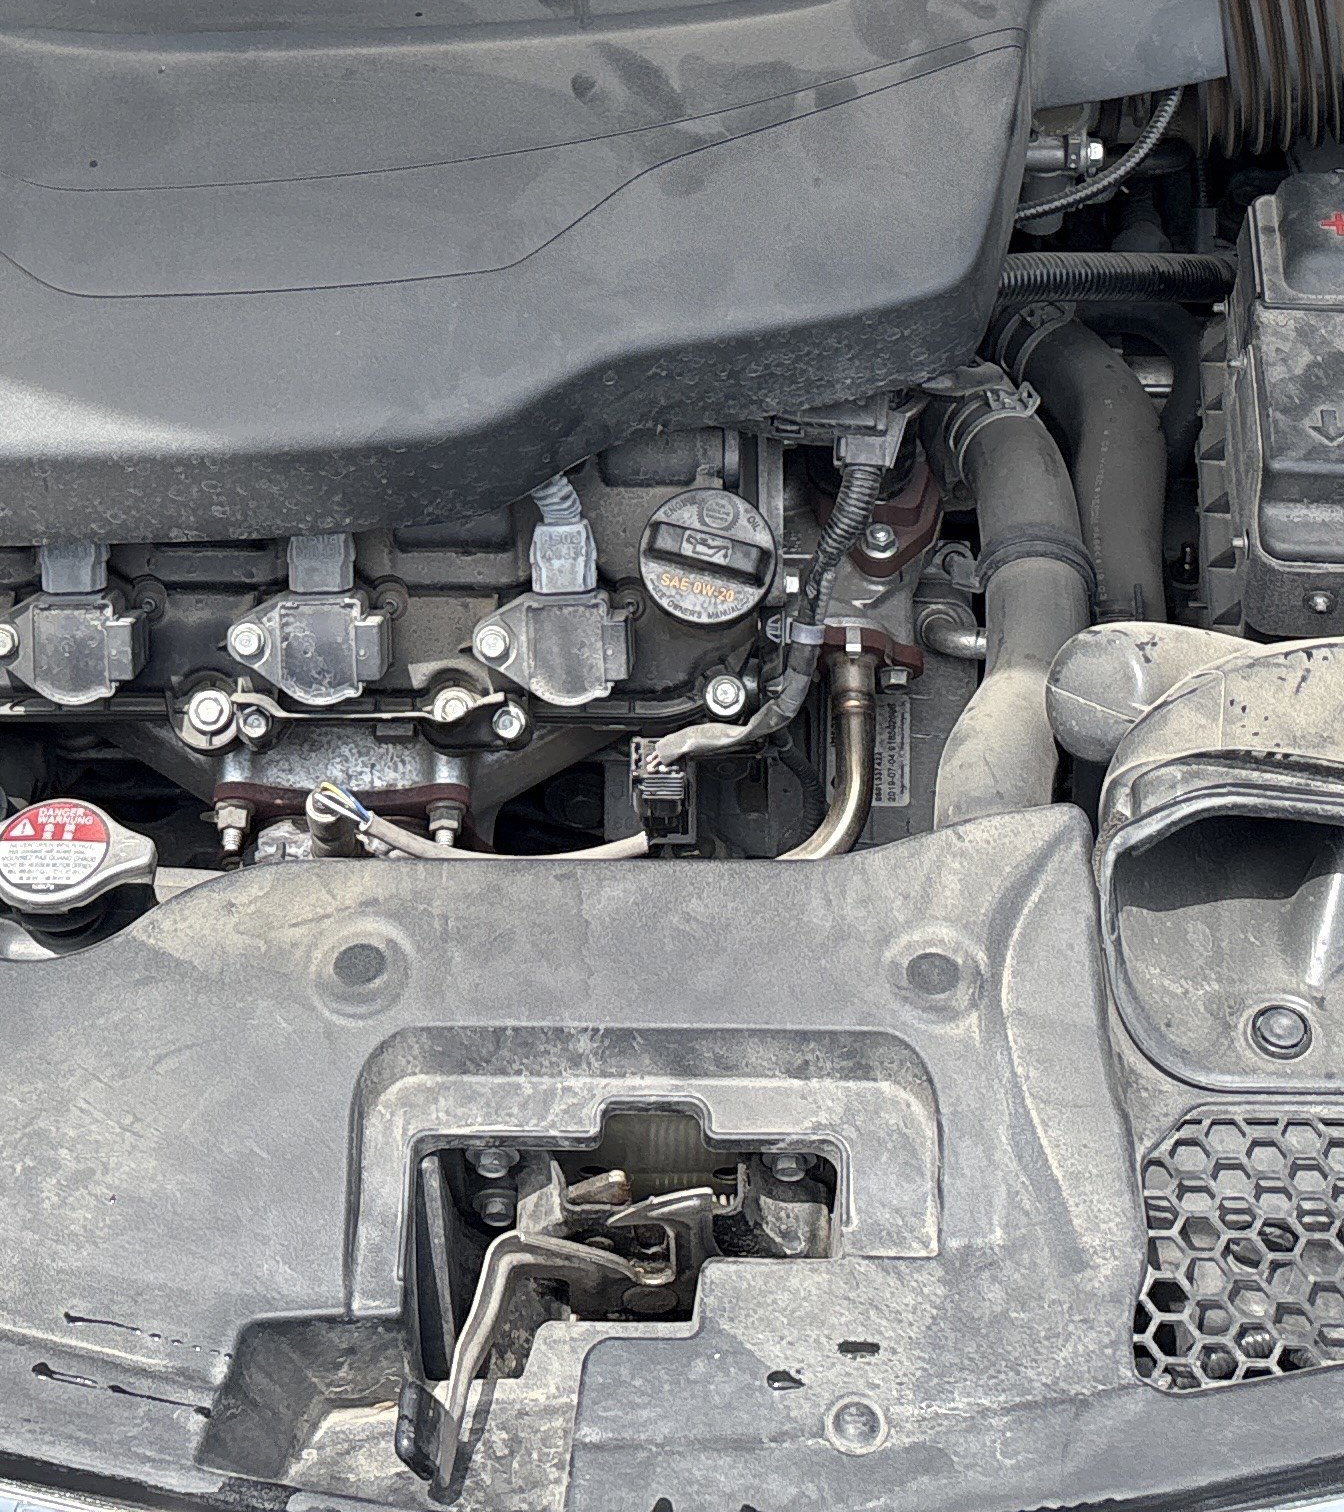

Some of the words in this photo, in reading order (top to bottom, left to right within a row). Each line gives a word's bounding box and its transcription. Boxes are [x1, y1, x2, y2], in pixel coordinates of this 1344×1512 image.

[660, 572, 690, 591] SAE
[692, 581, 735, 603] 0W-20
[38, 807, 85, 816] DANGER
[38, 815, 94, 825] WARNUNG
